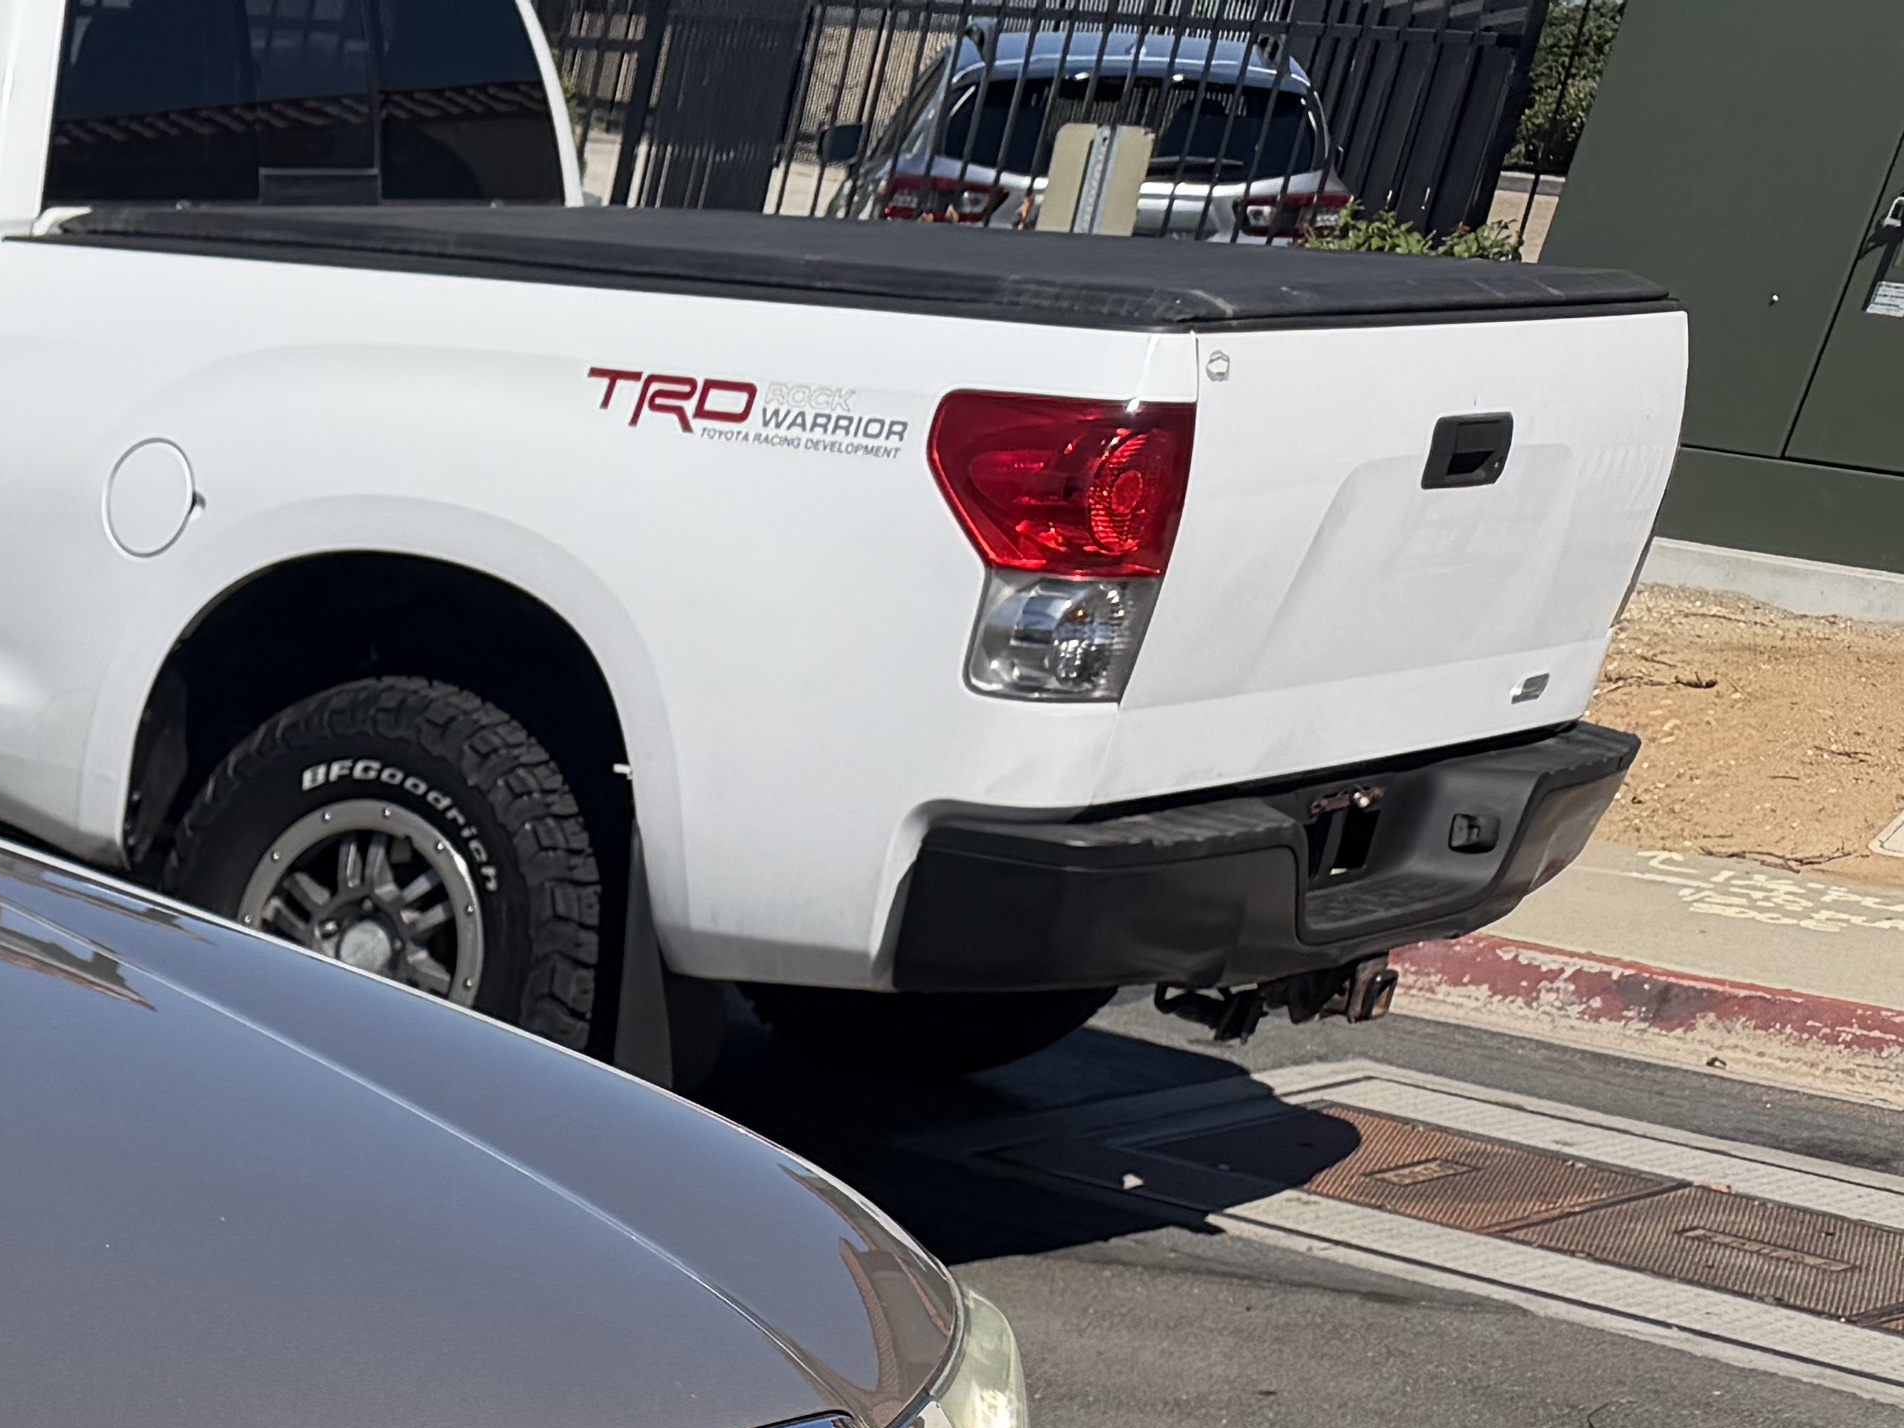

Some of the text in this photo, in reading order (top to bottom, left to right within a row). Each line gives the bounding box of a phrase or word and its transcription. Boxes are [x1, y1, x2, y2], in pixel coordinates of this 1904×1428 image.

[587, 366, 758, 434] TRD
[764, 381, 856, 412] ROCK
[761, 406, 909, 442] WARRIOR
[700, 426, 902, 459] TOYOTA RACING DEVELOPMENT
[301, 758, 498, 892] BFGoodrich
